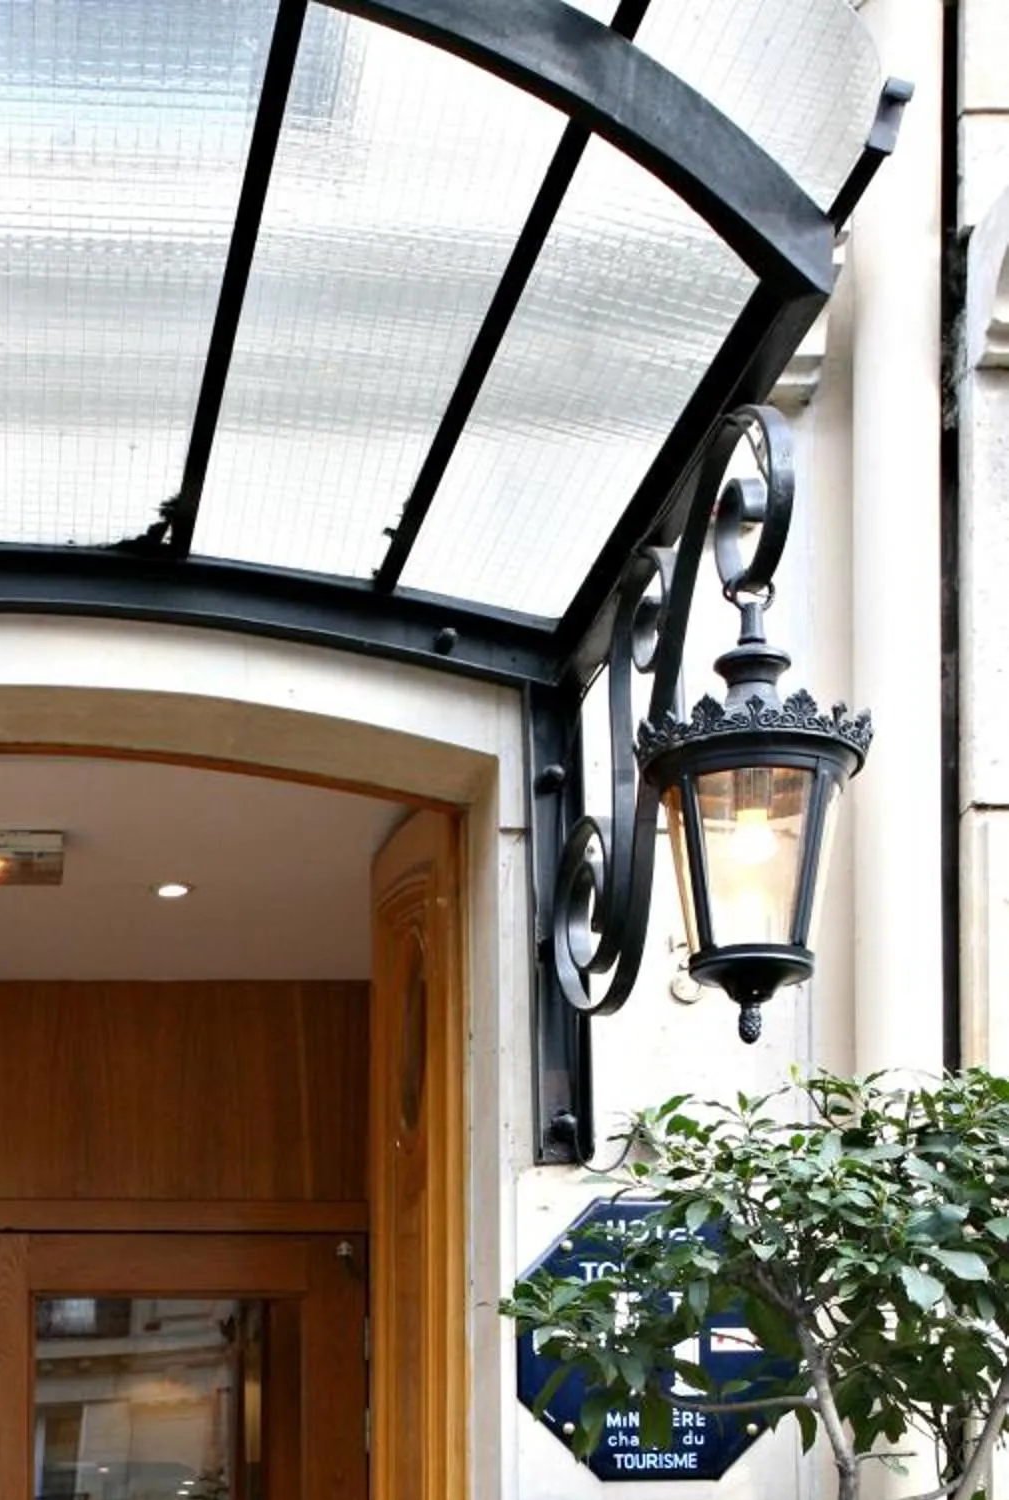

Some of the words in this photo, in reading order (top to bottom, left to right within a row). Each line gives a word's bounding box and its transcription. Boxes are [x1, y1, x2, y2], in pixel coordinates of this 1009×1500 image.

[606, 1407, 706, 1428] MINÈRE
[682, 1429, 705, 1446] du
[613, 1453, 698, 1469] TOURISME
